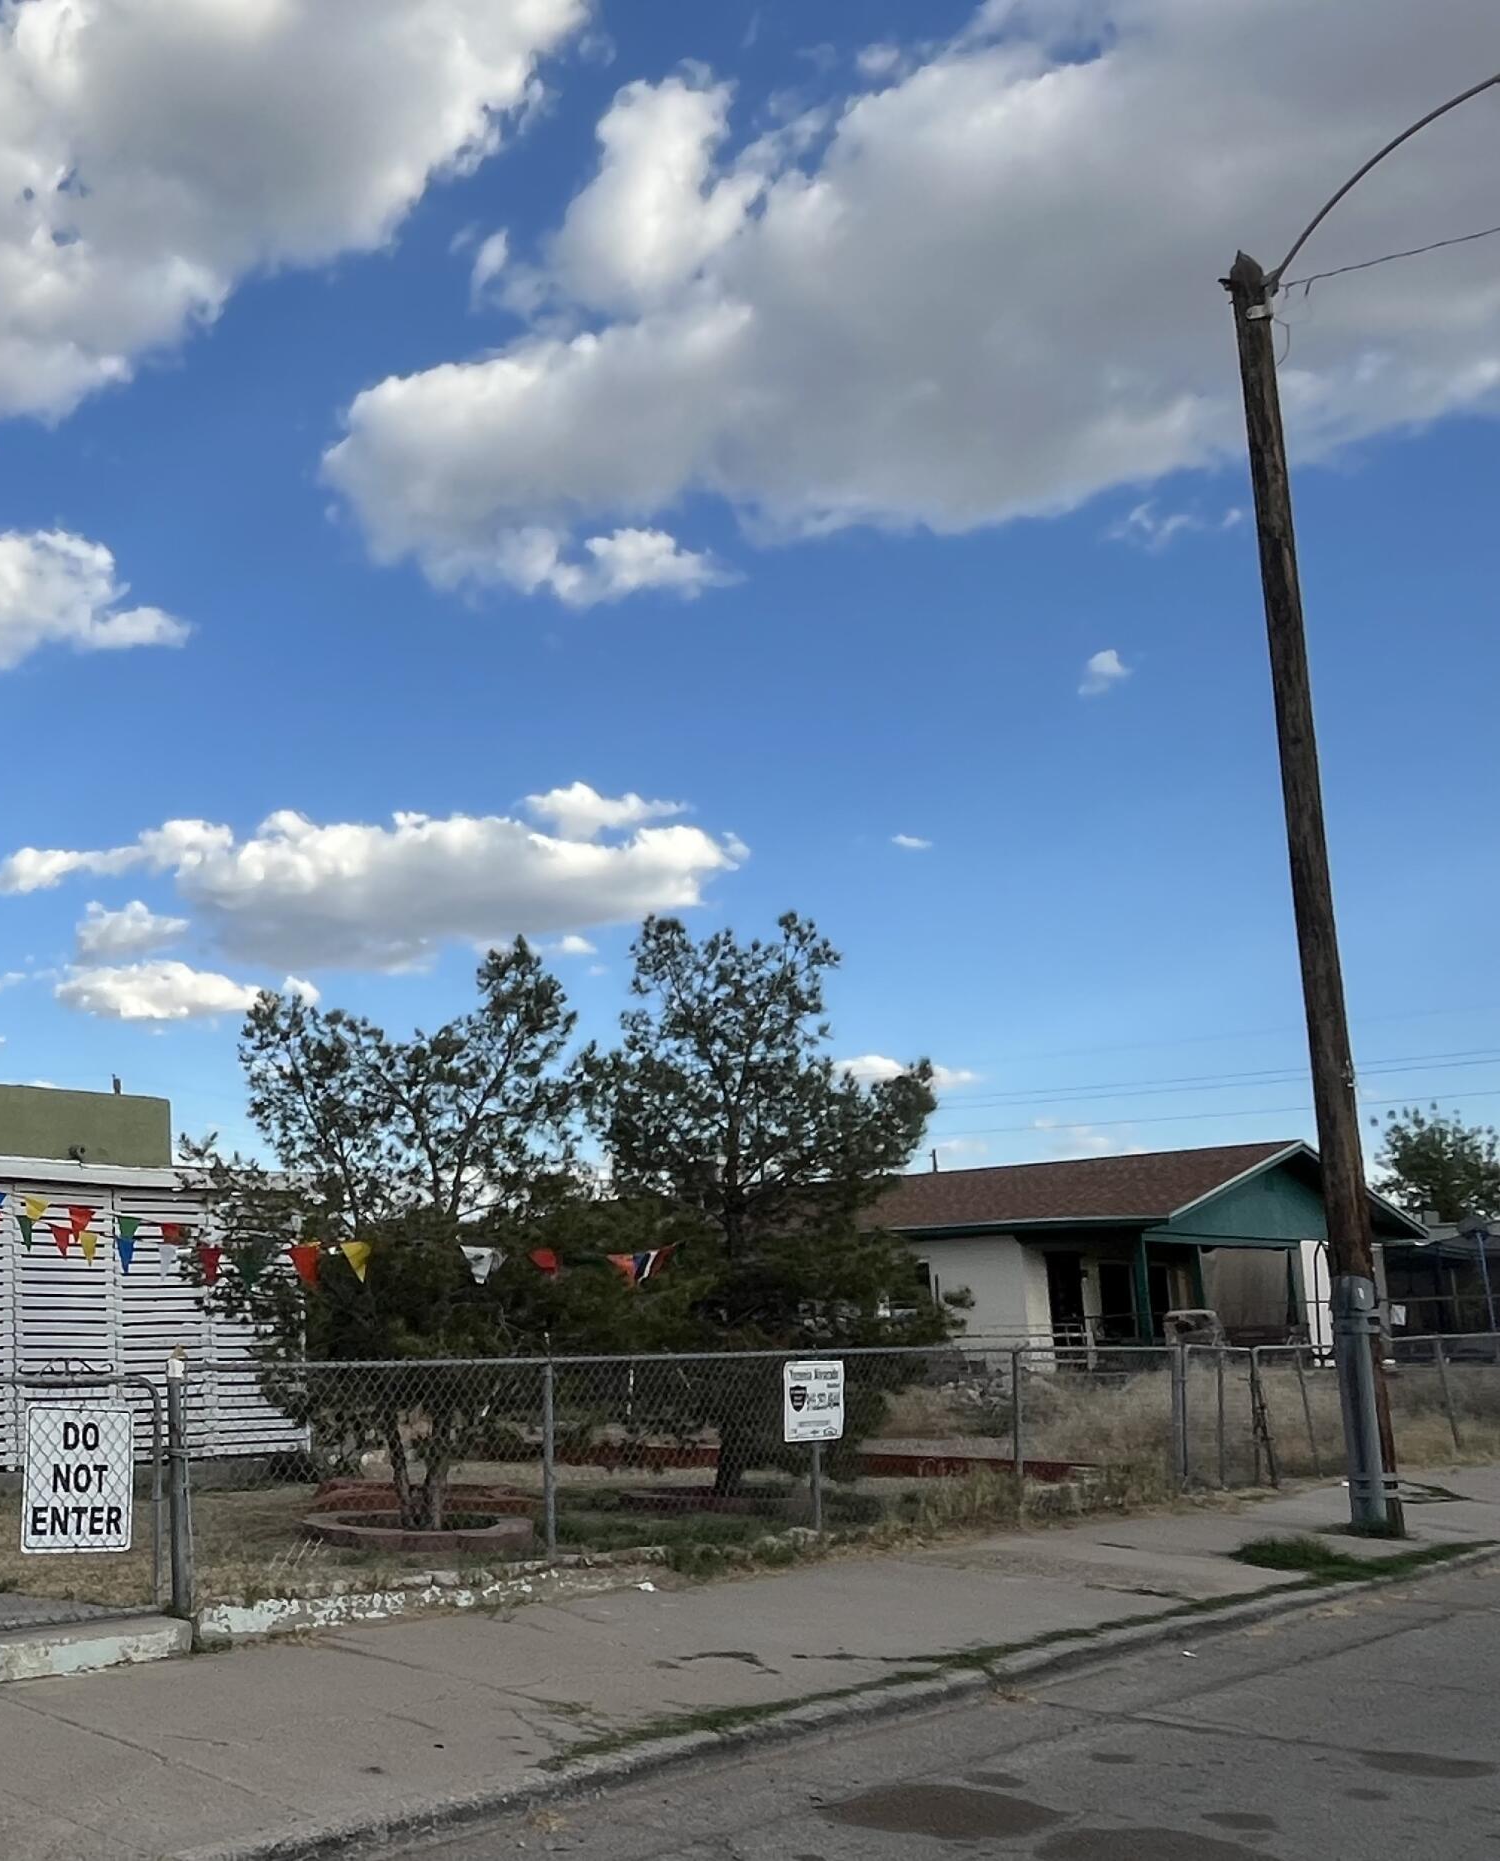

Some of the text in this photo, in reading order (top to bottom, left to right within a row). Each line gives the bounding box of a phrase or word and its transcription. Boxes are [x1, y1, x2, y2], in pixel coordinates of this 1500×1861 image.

[62, 1421, 100, 1451] DO
[51, 1463, 109, 1493] NOT
[30, 1506, 122, 1536] ENTER
